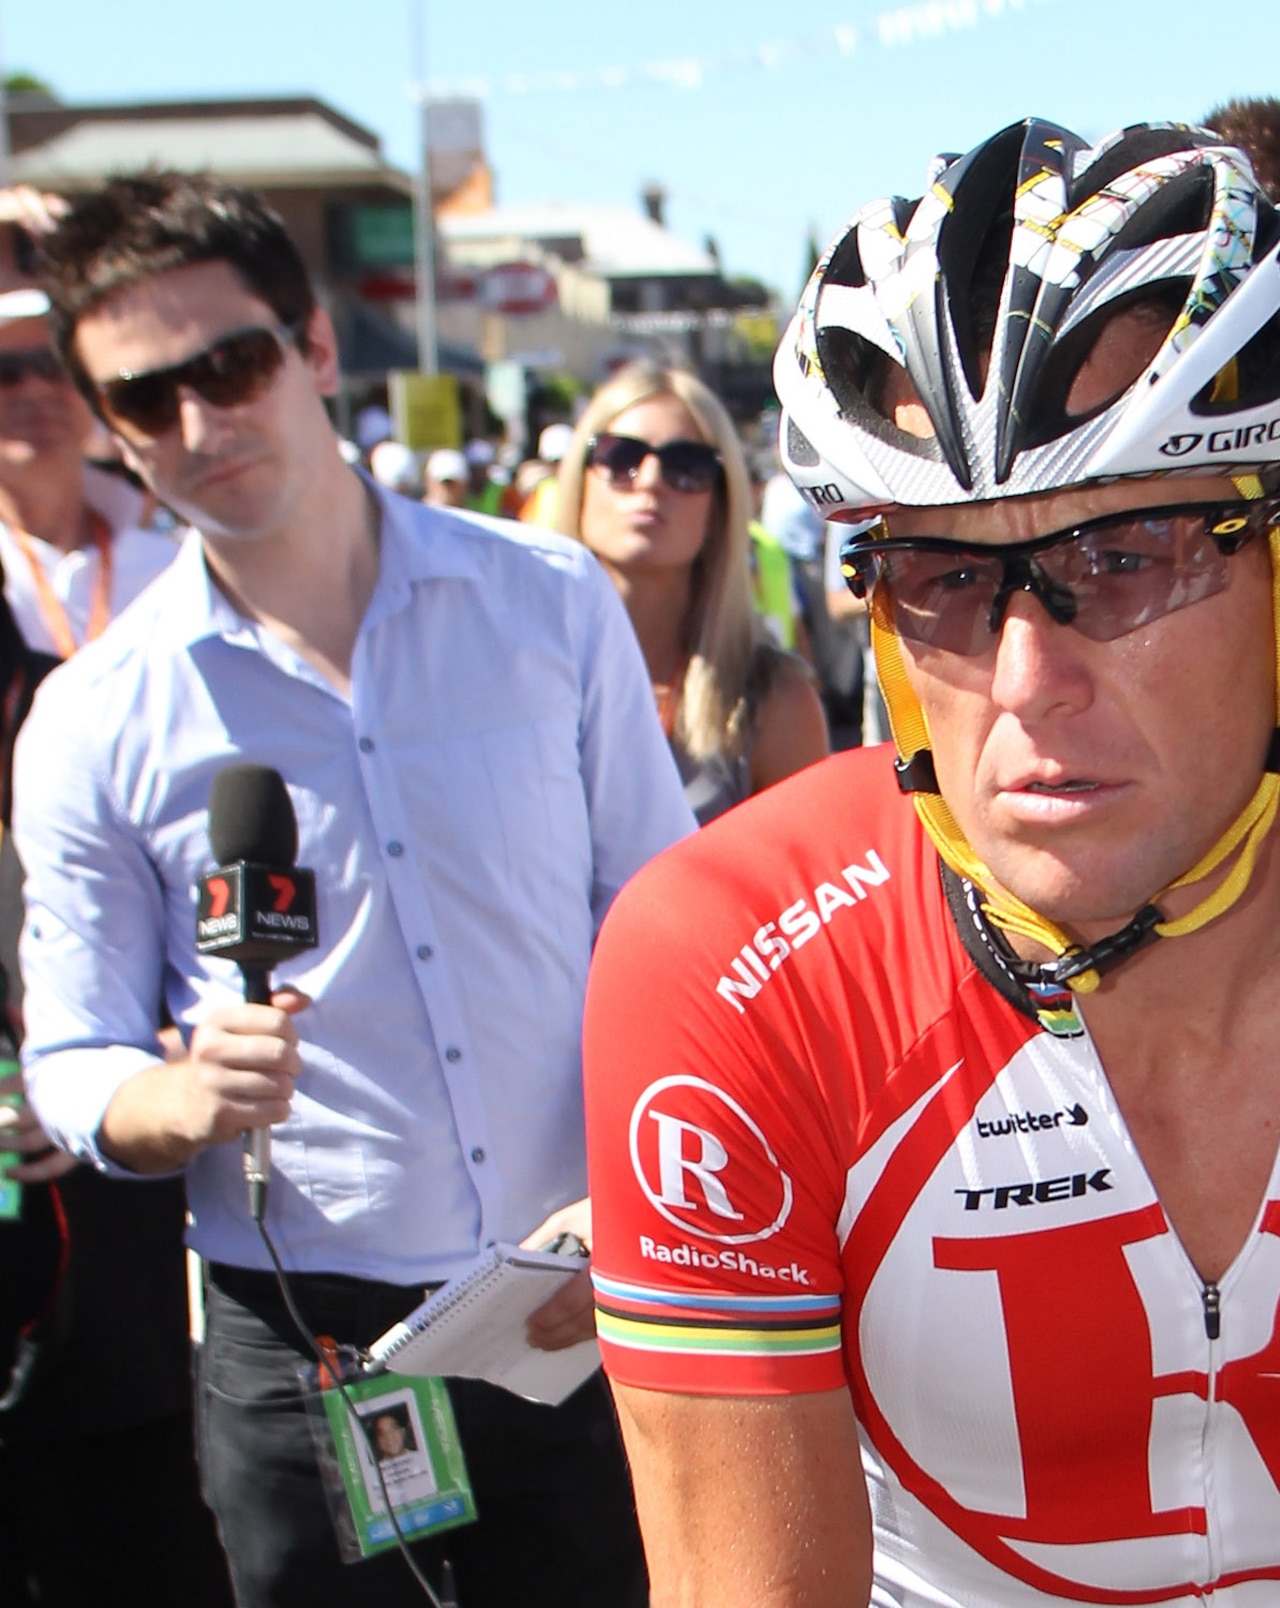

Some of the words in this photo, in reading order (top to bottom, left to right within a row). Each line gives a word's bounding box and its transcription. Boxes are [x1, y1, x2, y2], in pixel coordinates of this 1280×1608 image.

[199, 912, 238, 936] NEWS
[257, 911, 309, 930] NEWS
[716, 849, 891, 1015] NISSAN
[976, 1111, 1064, 1138] twitter
[954, 1169, 1114, 1211] TREK
[639, 1235, 810, 1286] RadioShack
